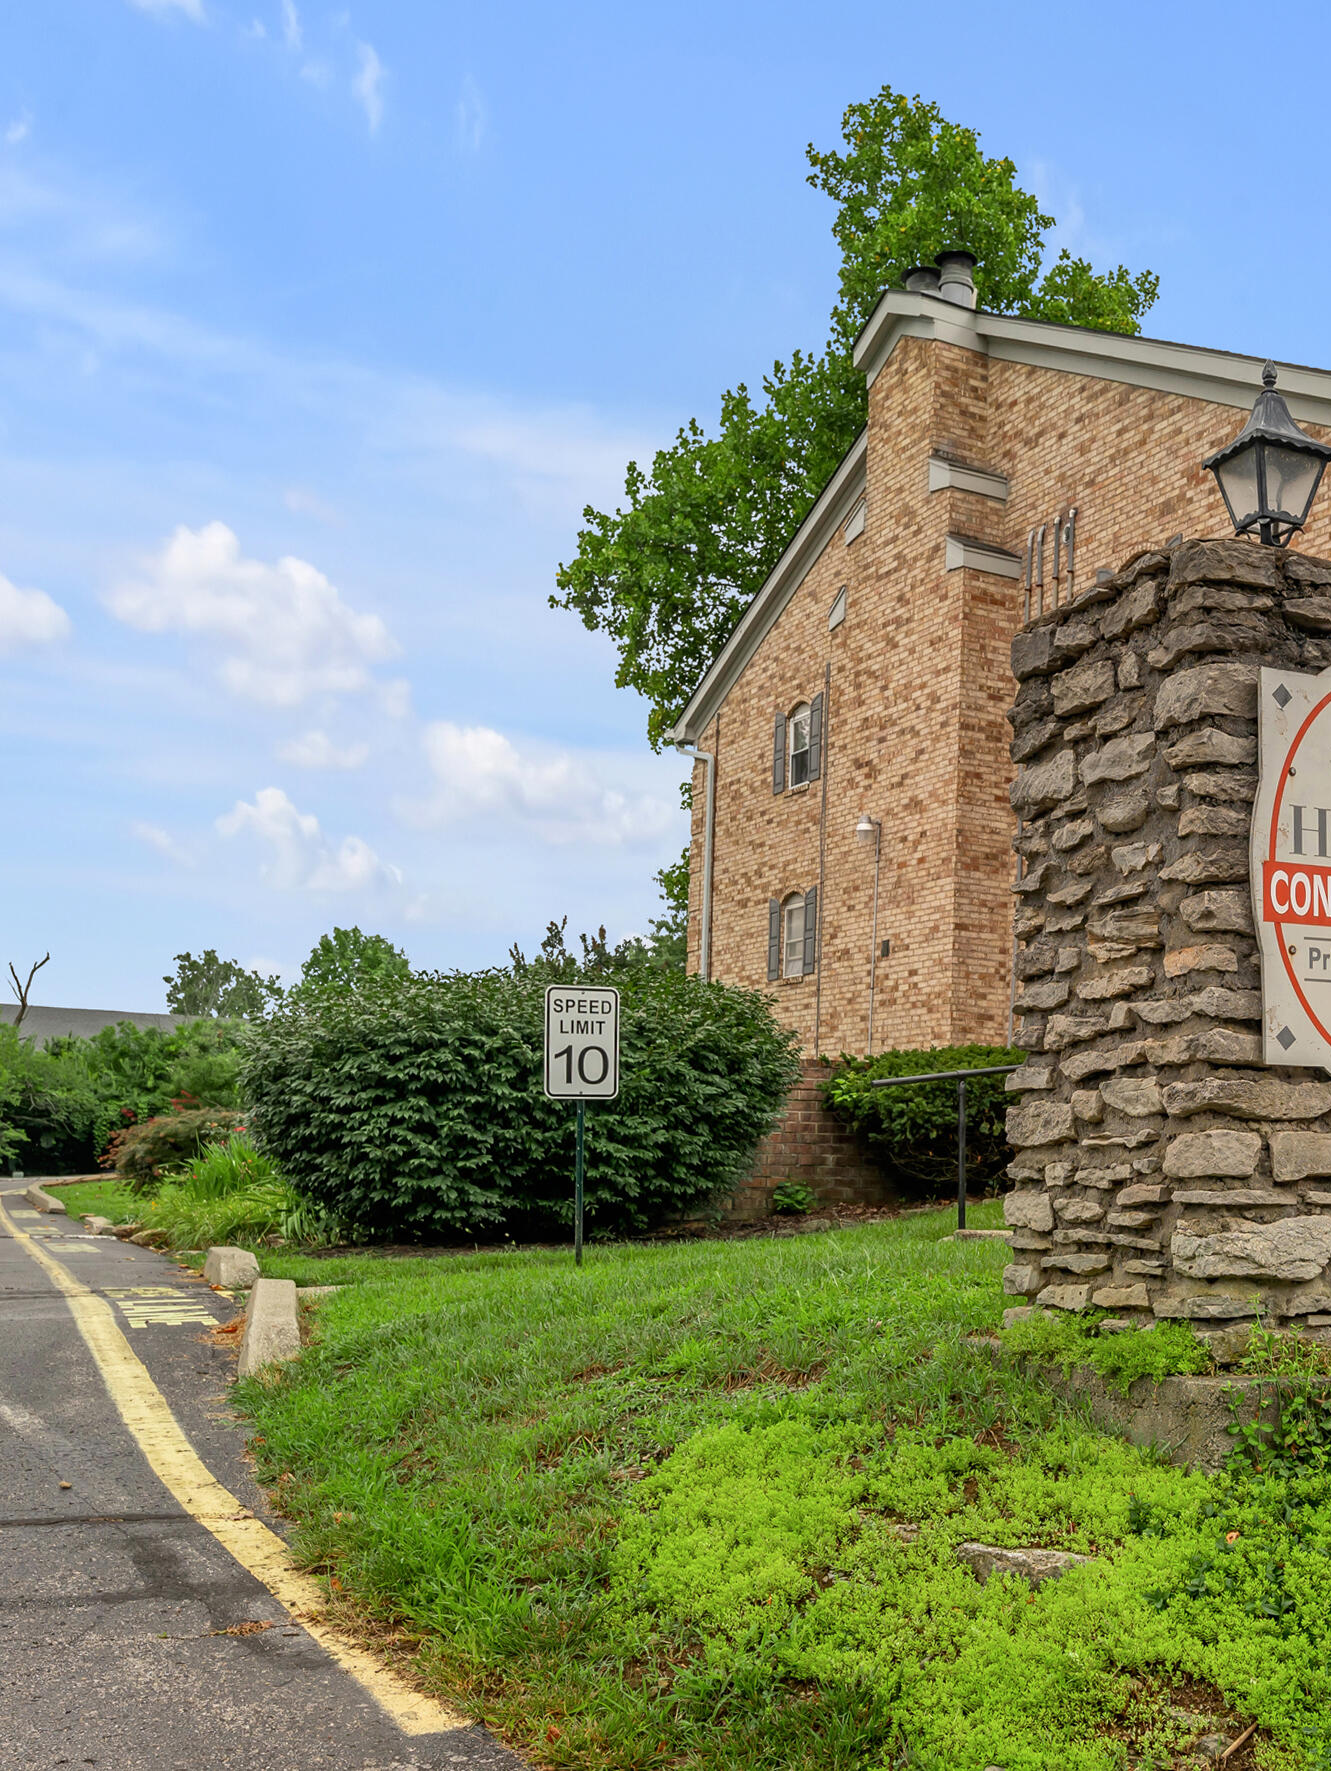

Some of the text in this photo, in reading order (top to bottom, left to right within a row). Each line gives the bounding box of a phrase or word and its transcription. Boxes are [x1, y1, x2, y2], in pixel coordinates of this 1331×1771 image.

[553, 998, 612, 1015] SPEED
[560, 1019, 606, 1035] LIMIT
[554, 1044, 609, 1085] 10
